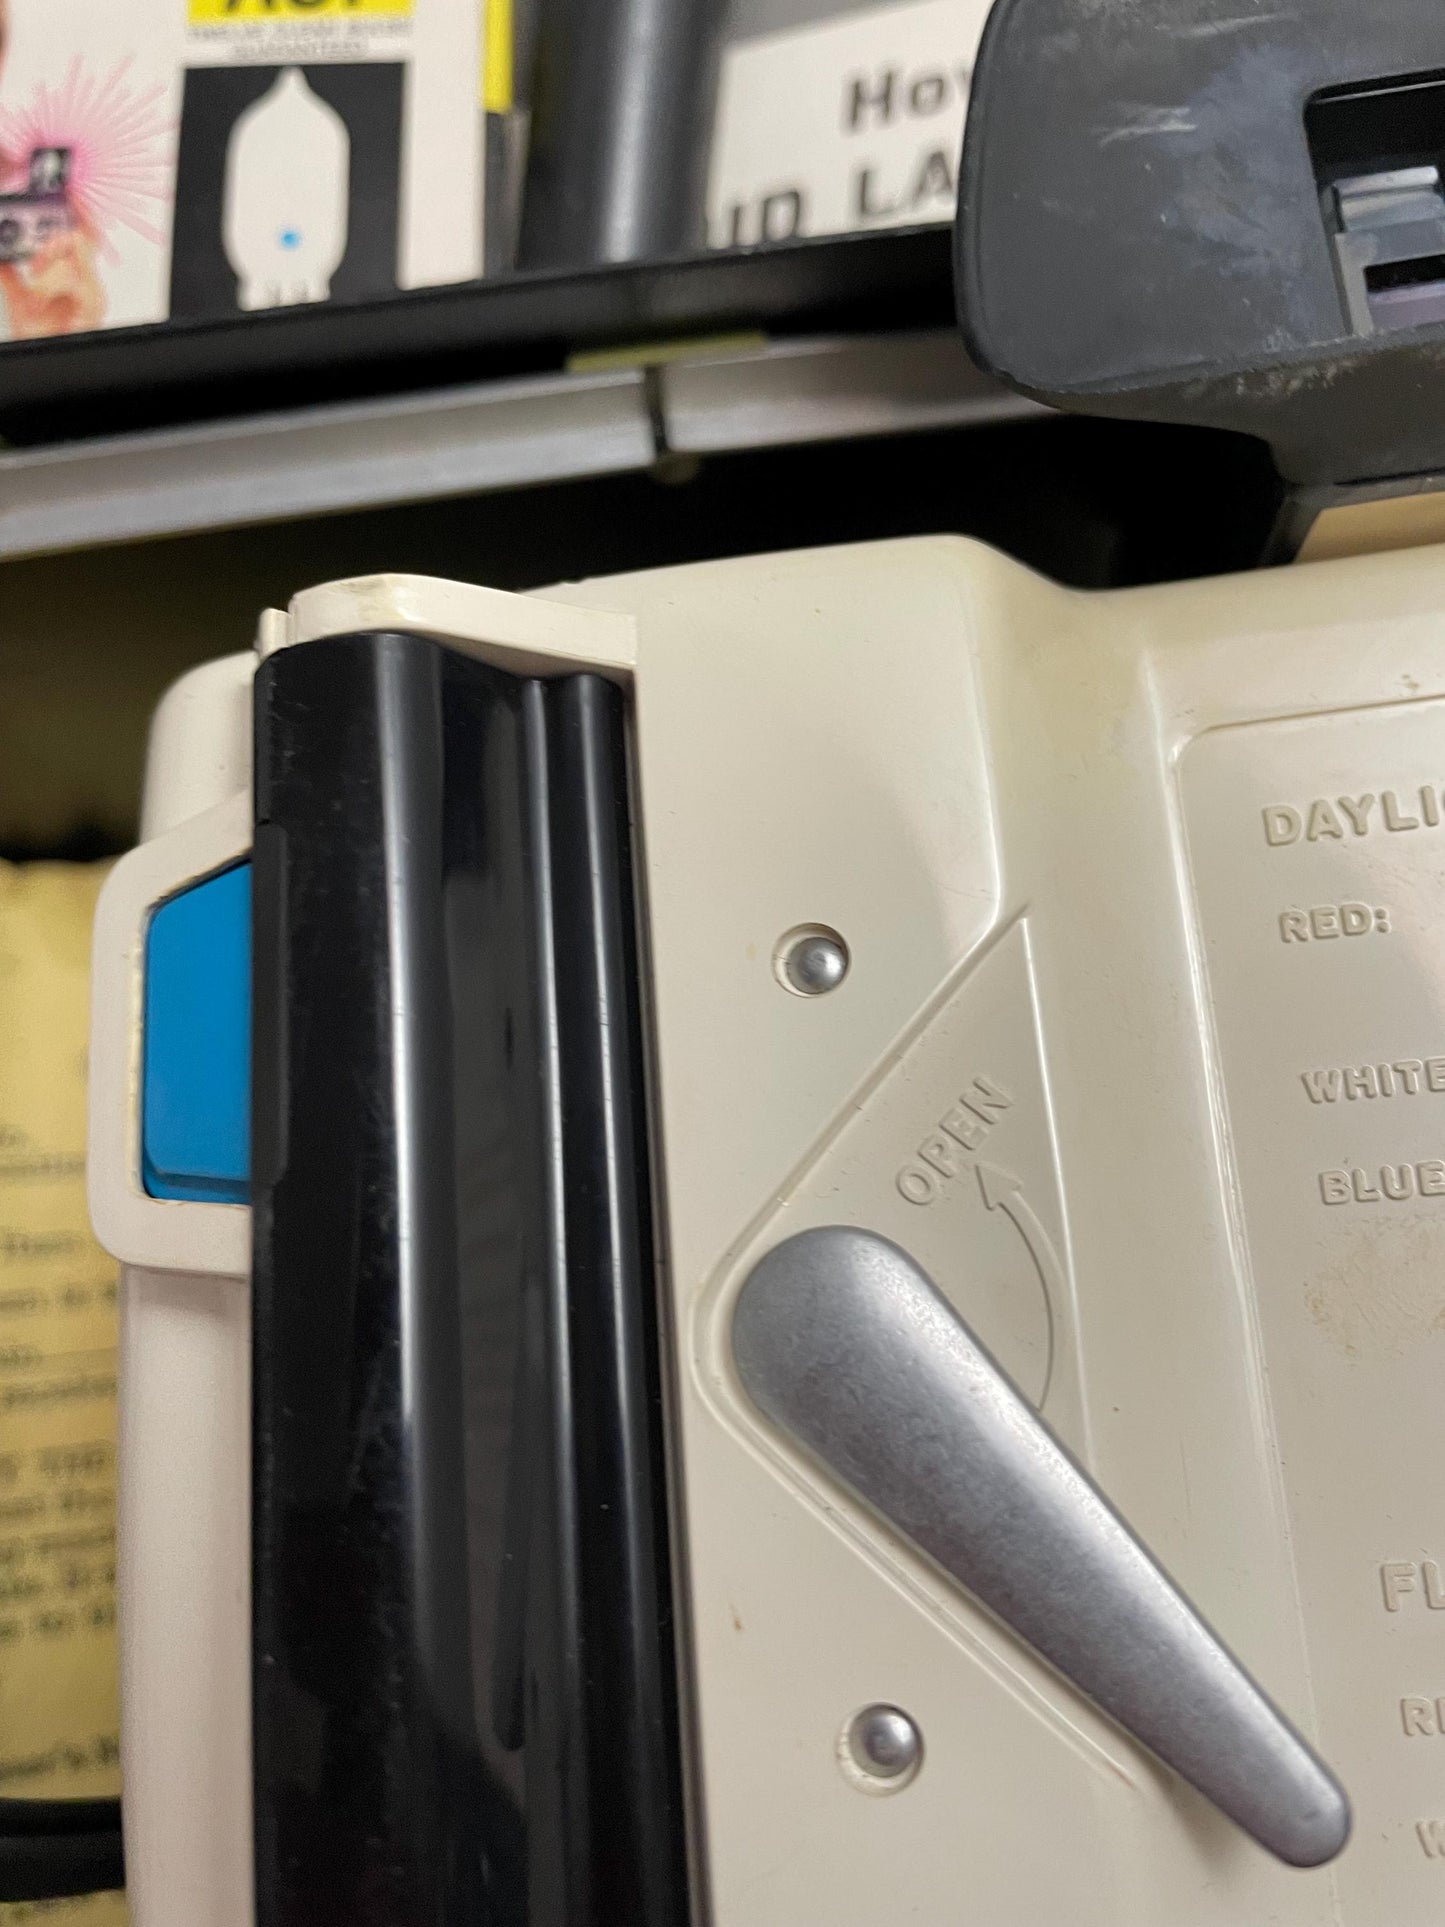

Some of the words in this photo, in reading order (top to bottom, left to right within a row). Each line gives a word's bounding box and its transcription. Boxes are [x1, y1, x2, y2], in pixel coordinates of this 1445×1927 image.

[1261, 785, 1445, 847] DAYLI
[1278, 901, 1392, 944] RED:
[1302, 1056, 1445, 1104] WHITE
[895, 1077, 1013, 1206] OPEN
[1318, 1160, 1445, 1206] BLUE
[1400, 1697, 1445, 1736] R
